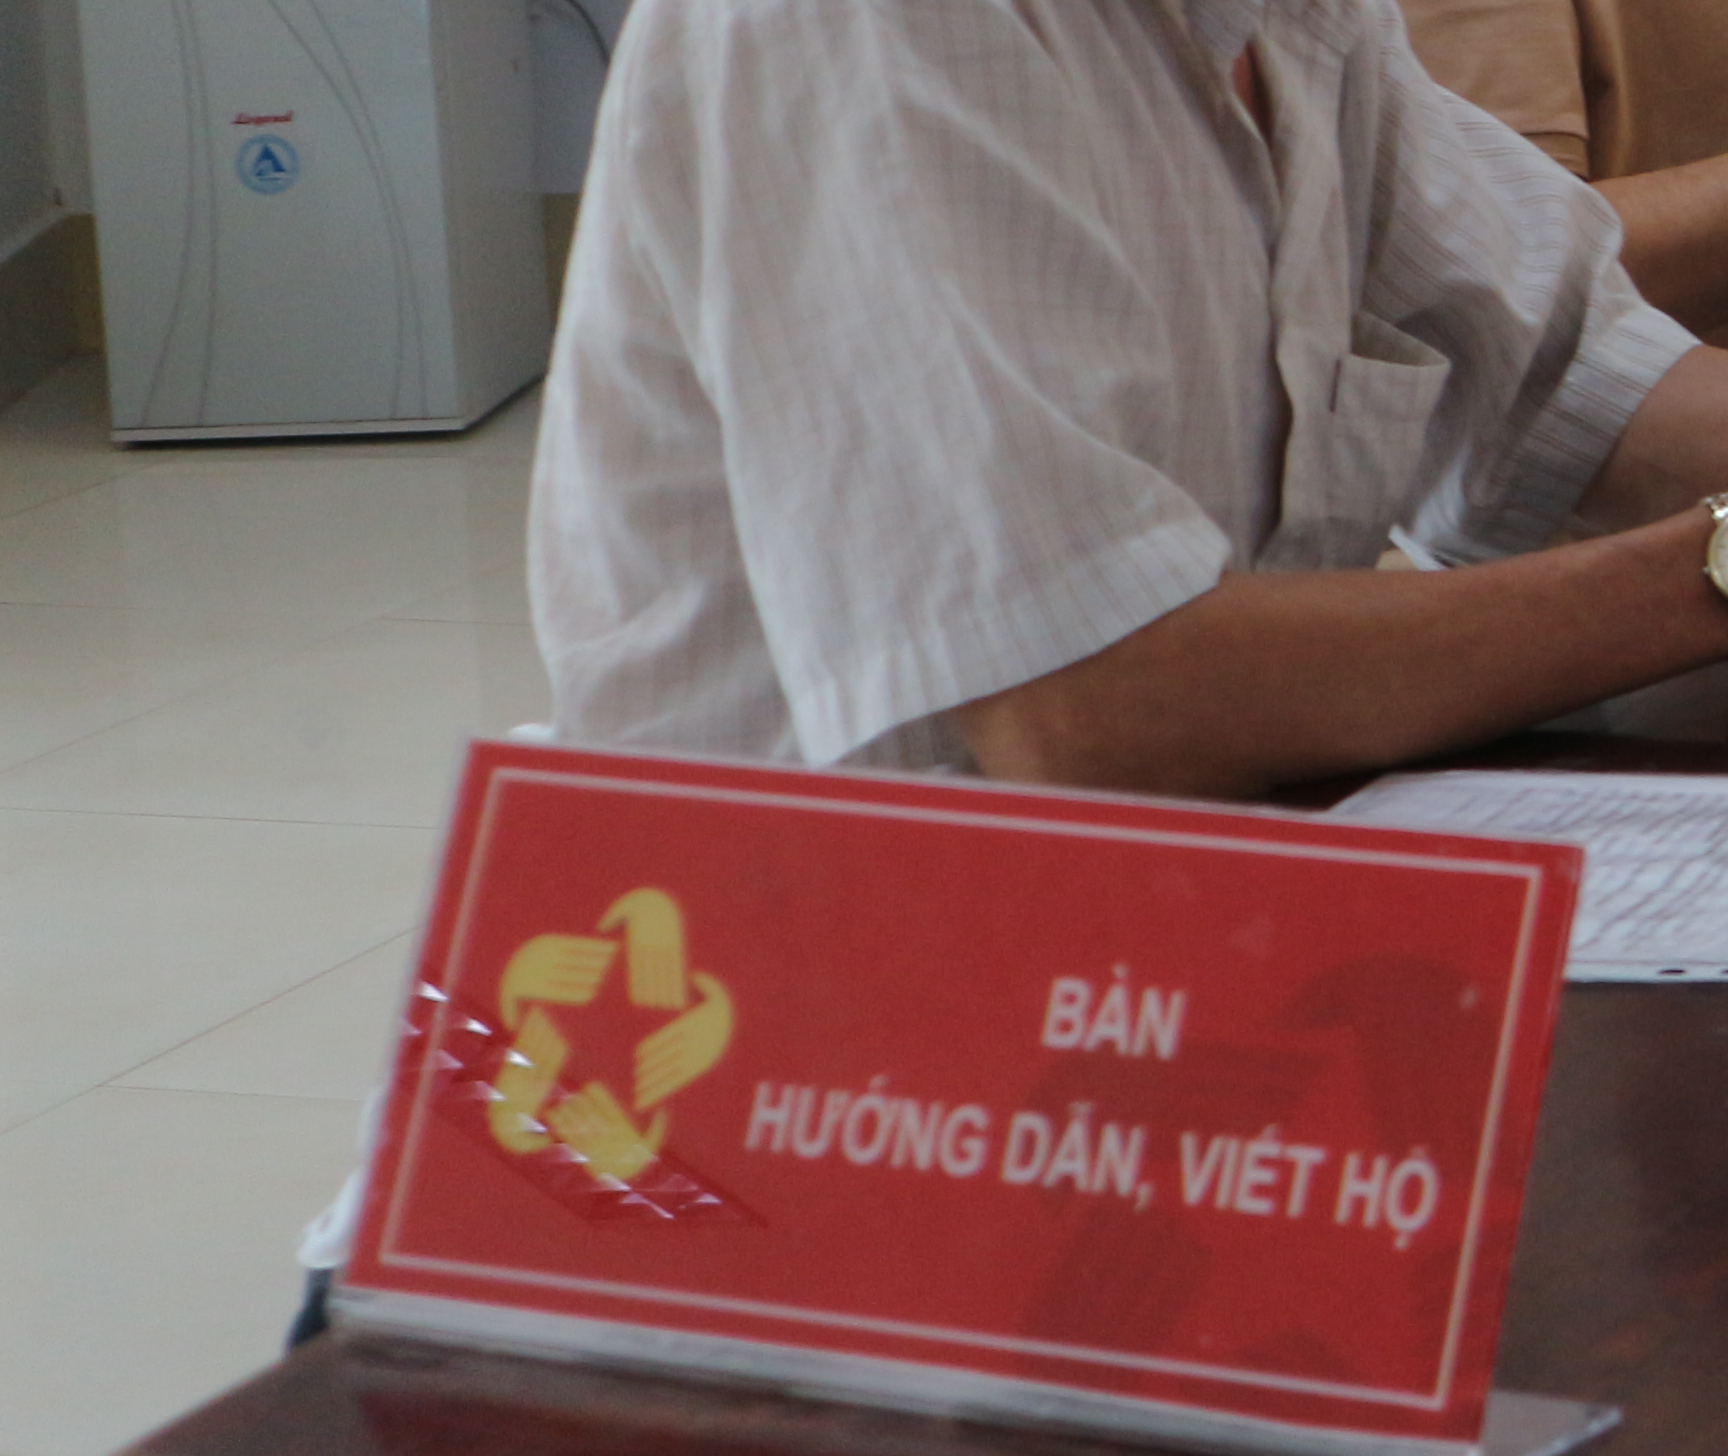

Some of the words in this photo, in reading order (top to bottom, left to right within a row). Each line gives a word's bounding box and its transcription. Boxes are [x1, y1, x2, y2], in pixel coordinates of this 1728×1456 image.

[744, 1074, 989, 1179] HƯỚNG
[1001, 1099, 1154, 1214] DẪN,
[1179, 1122, 1329, 1220] VIẾT
[1335, 1146, 1439, 1251] HỘ
